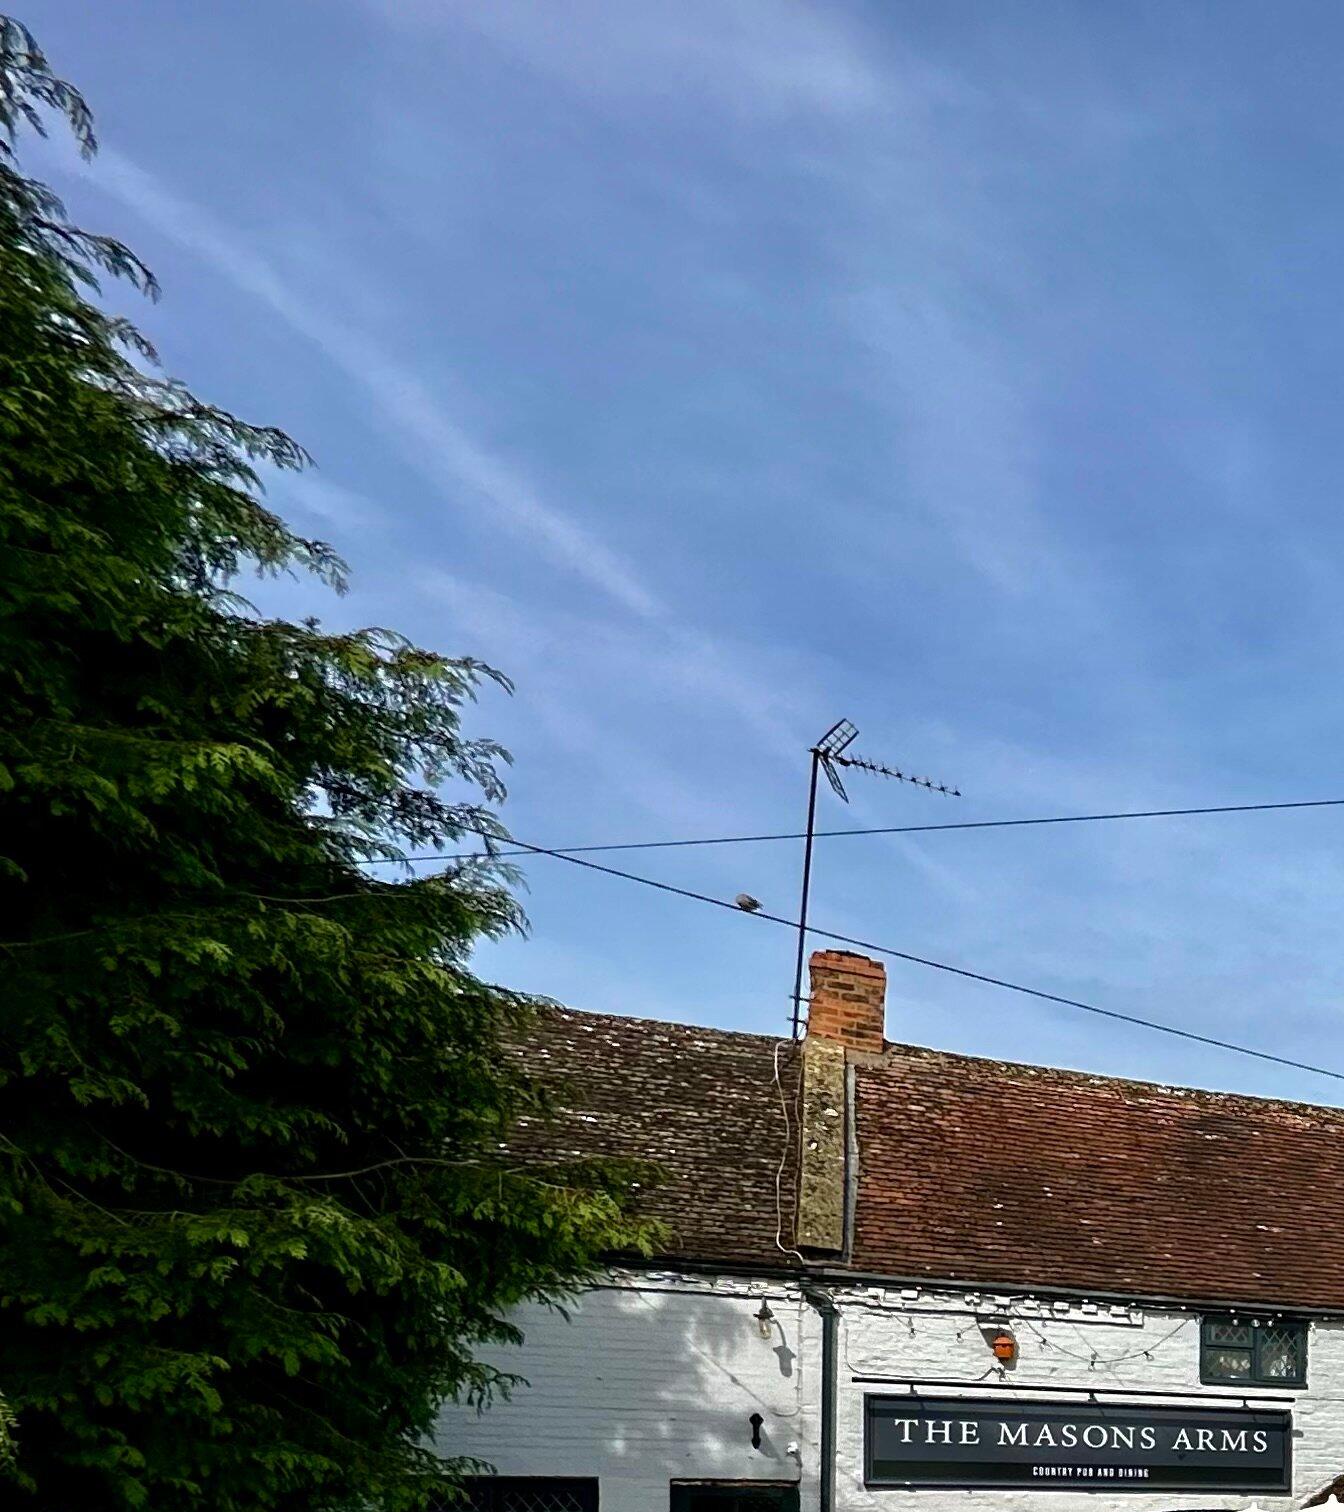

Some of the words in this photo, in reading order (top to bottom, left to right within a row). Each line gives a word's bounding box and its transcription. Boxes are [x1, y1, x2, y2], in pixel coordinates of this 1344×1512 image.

[894, 1418, 981, 1446] THE
[996, 1421, 1157, 1450] MASONS
[1171, 1428, 1269, 1453] ARMS
[1032, 1465, 1073, 1477] COUNTRY
[1097, 1467, 1115, 1478] AND
